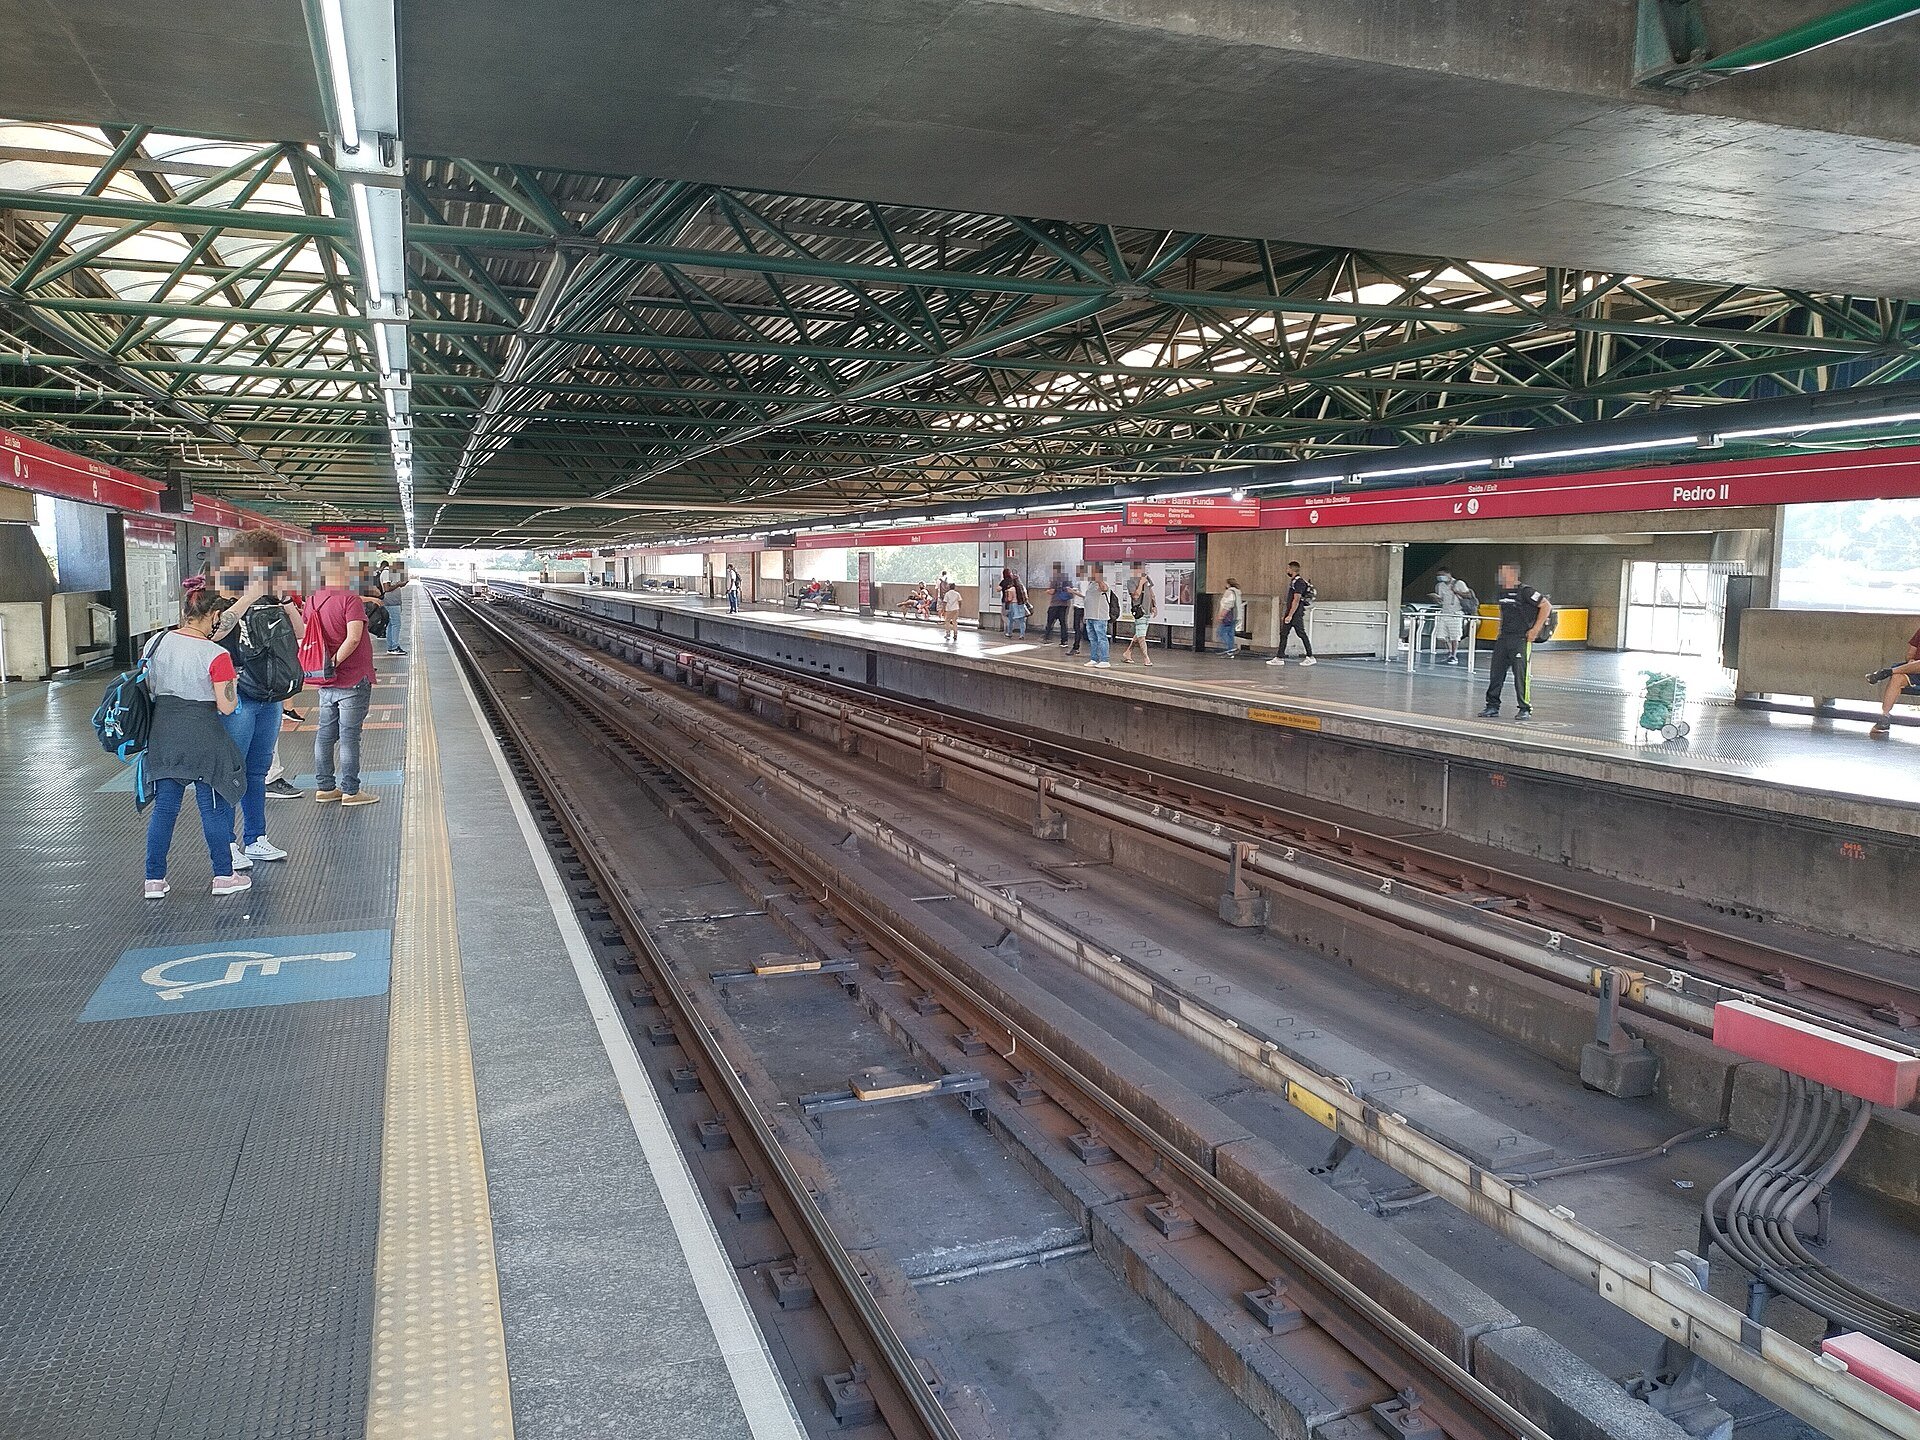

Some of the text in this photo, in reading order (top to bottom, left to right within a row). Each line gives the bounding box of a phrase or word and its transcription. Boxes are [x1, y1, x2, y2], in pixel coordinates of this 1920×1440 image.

[1673, 484, 1729, 501] Pedro II
[1100, 525, 1113, 533] Pedro
